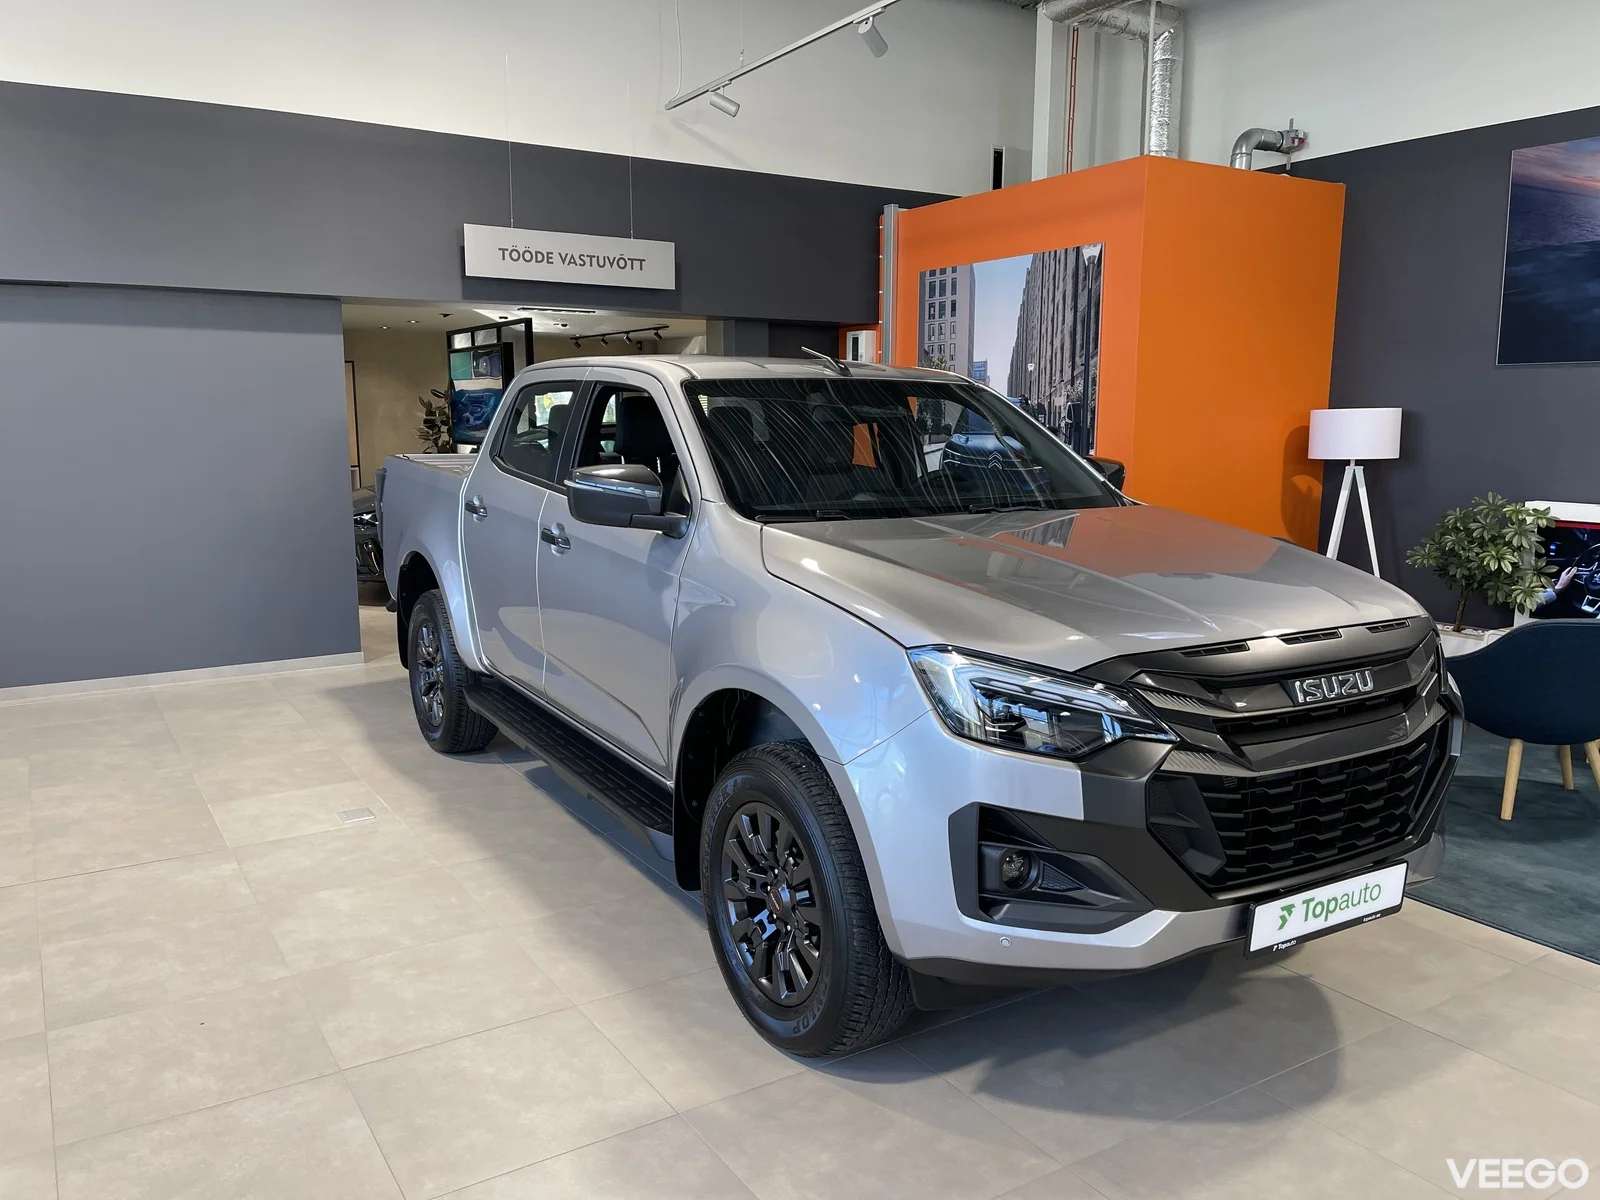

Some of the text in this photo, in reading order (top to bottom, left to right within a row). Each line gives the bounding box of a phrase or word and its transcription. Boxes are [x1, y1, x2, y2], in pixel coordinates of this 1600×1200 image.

[498, 245, 646, 271] TÖÖDE VASTUVÕTT
[1294, 670, 1374, 703] ISUZU
[1302, 882, 1382, 922] Topauto
